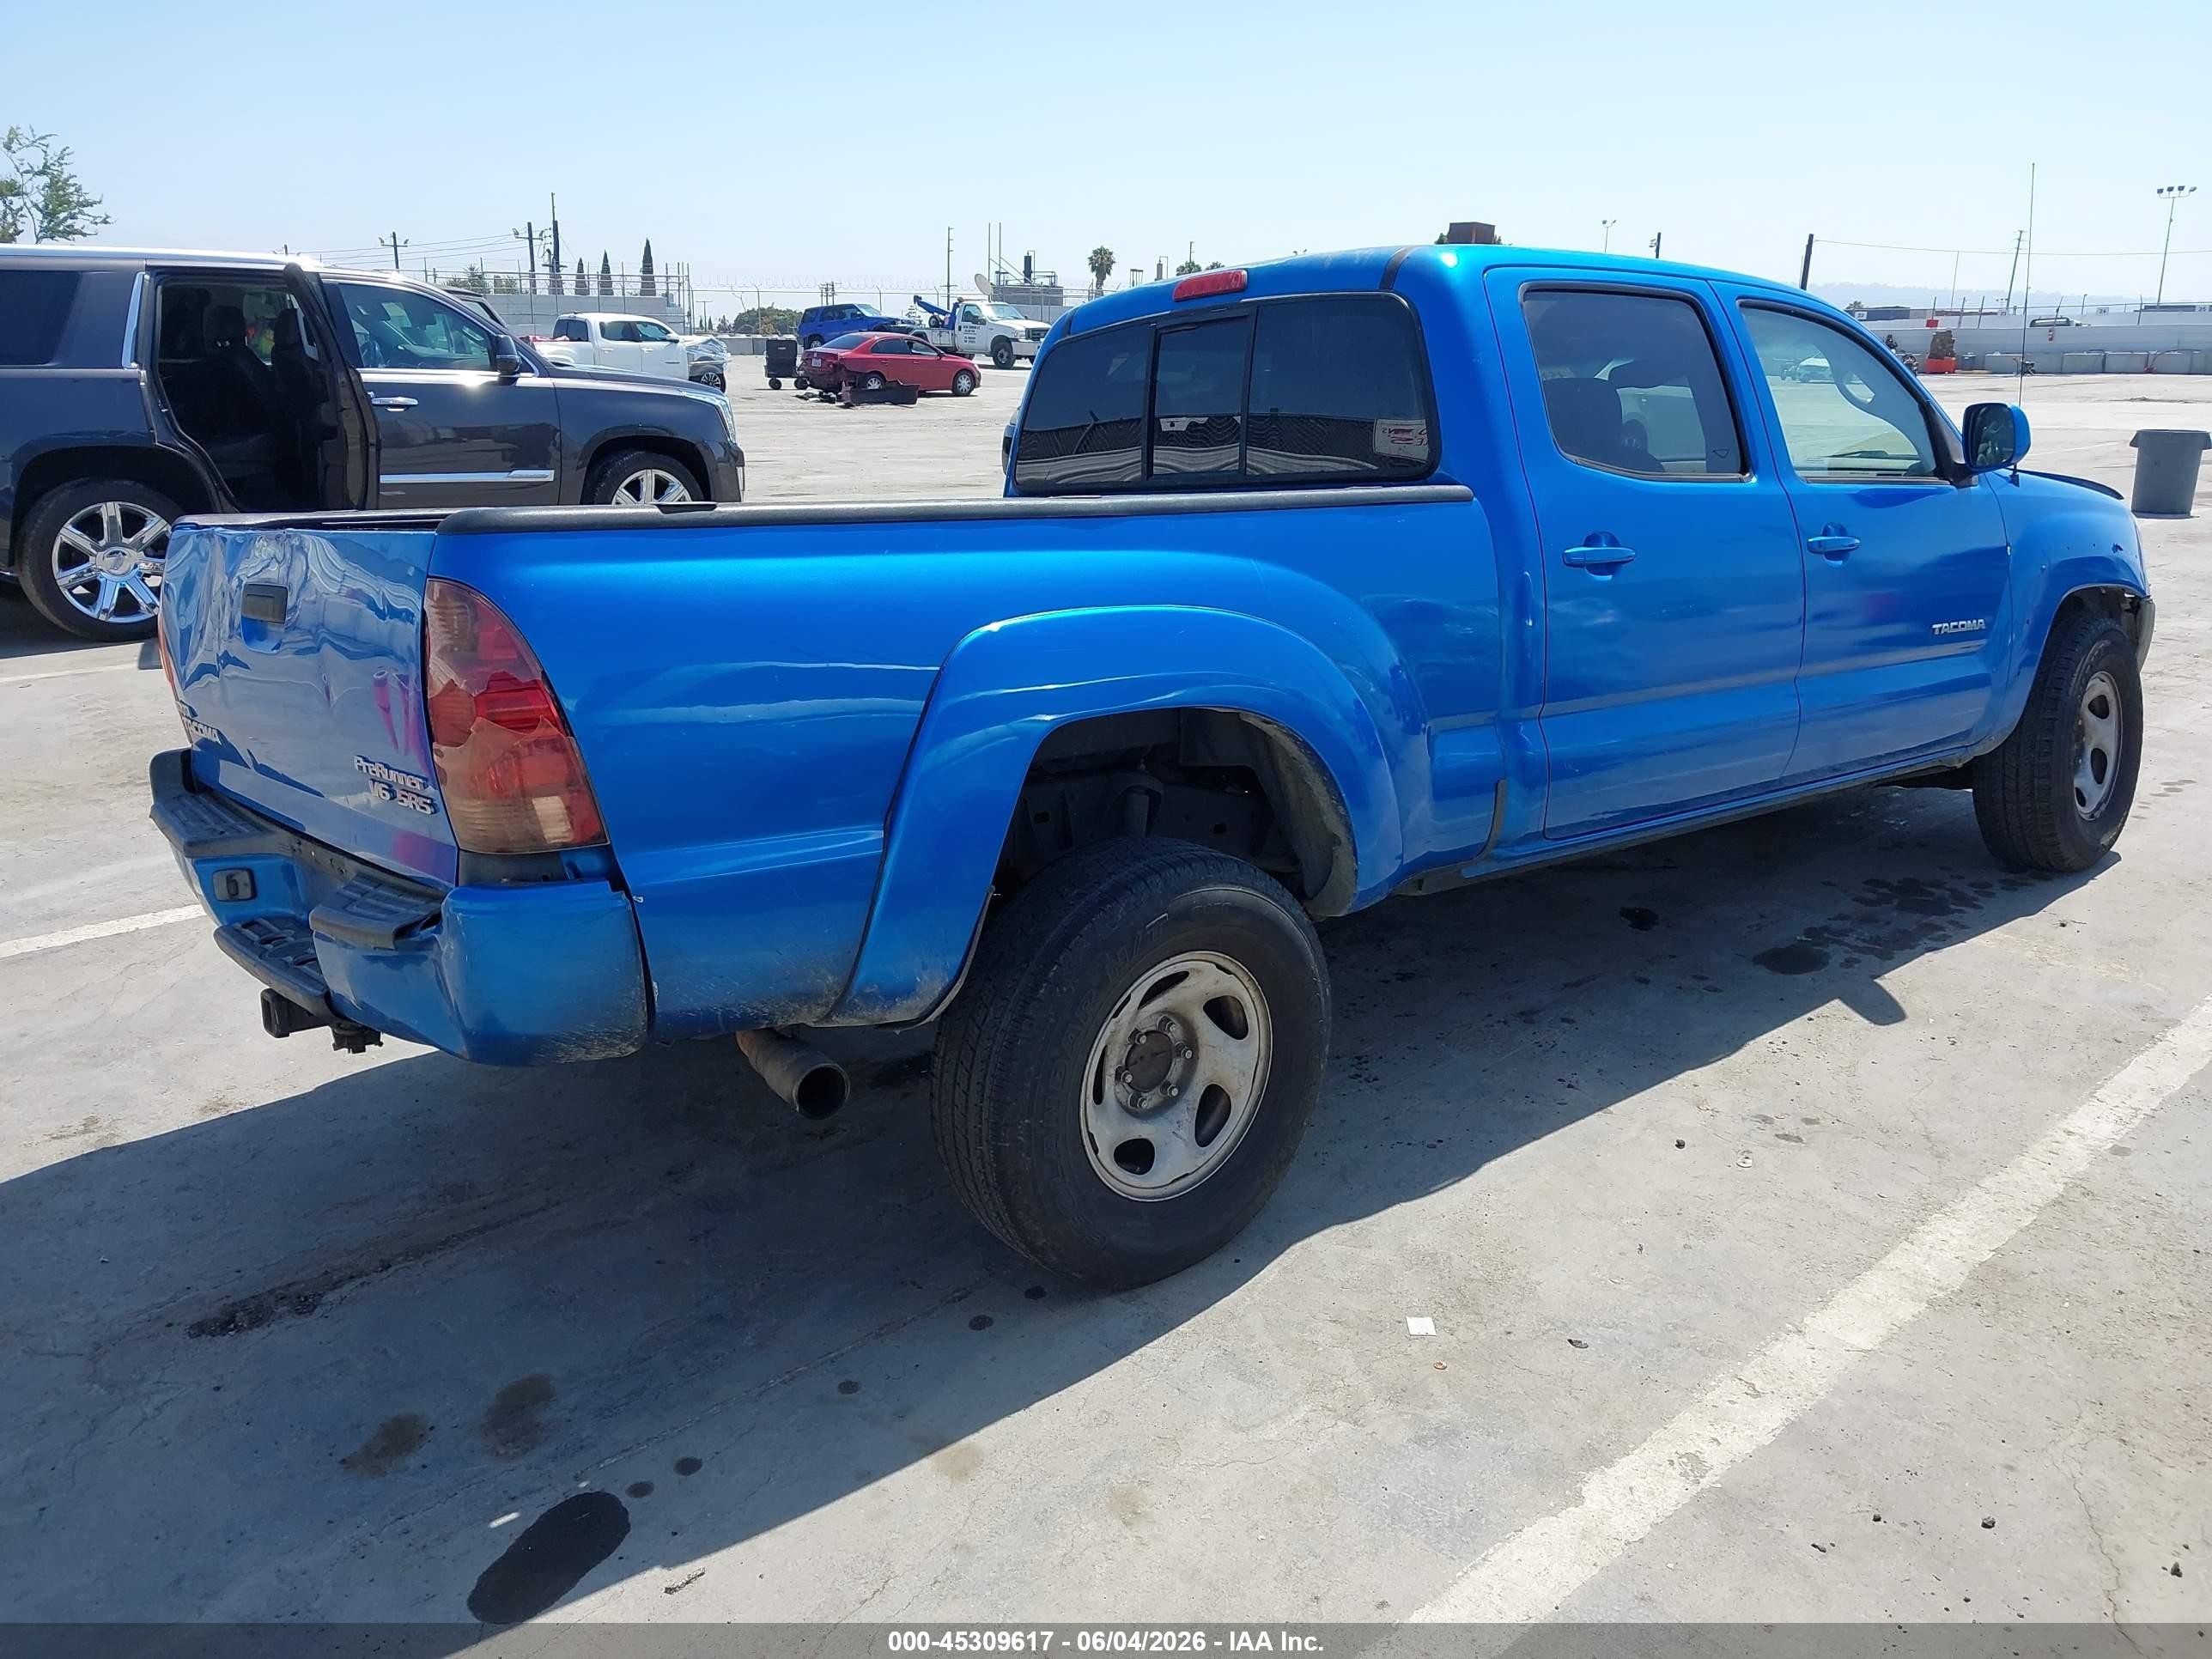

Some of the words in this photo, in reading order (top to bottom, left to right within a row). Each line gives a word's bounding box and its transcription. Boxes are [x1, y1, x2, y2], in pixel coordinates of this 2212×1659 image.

[1932, 619, 1986, 635] TACOMA
[354, 755, 427, 791] PreRunner
[368, 780, 392, 800] V6
[398, 791, 434, 815] SR5
